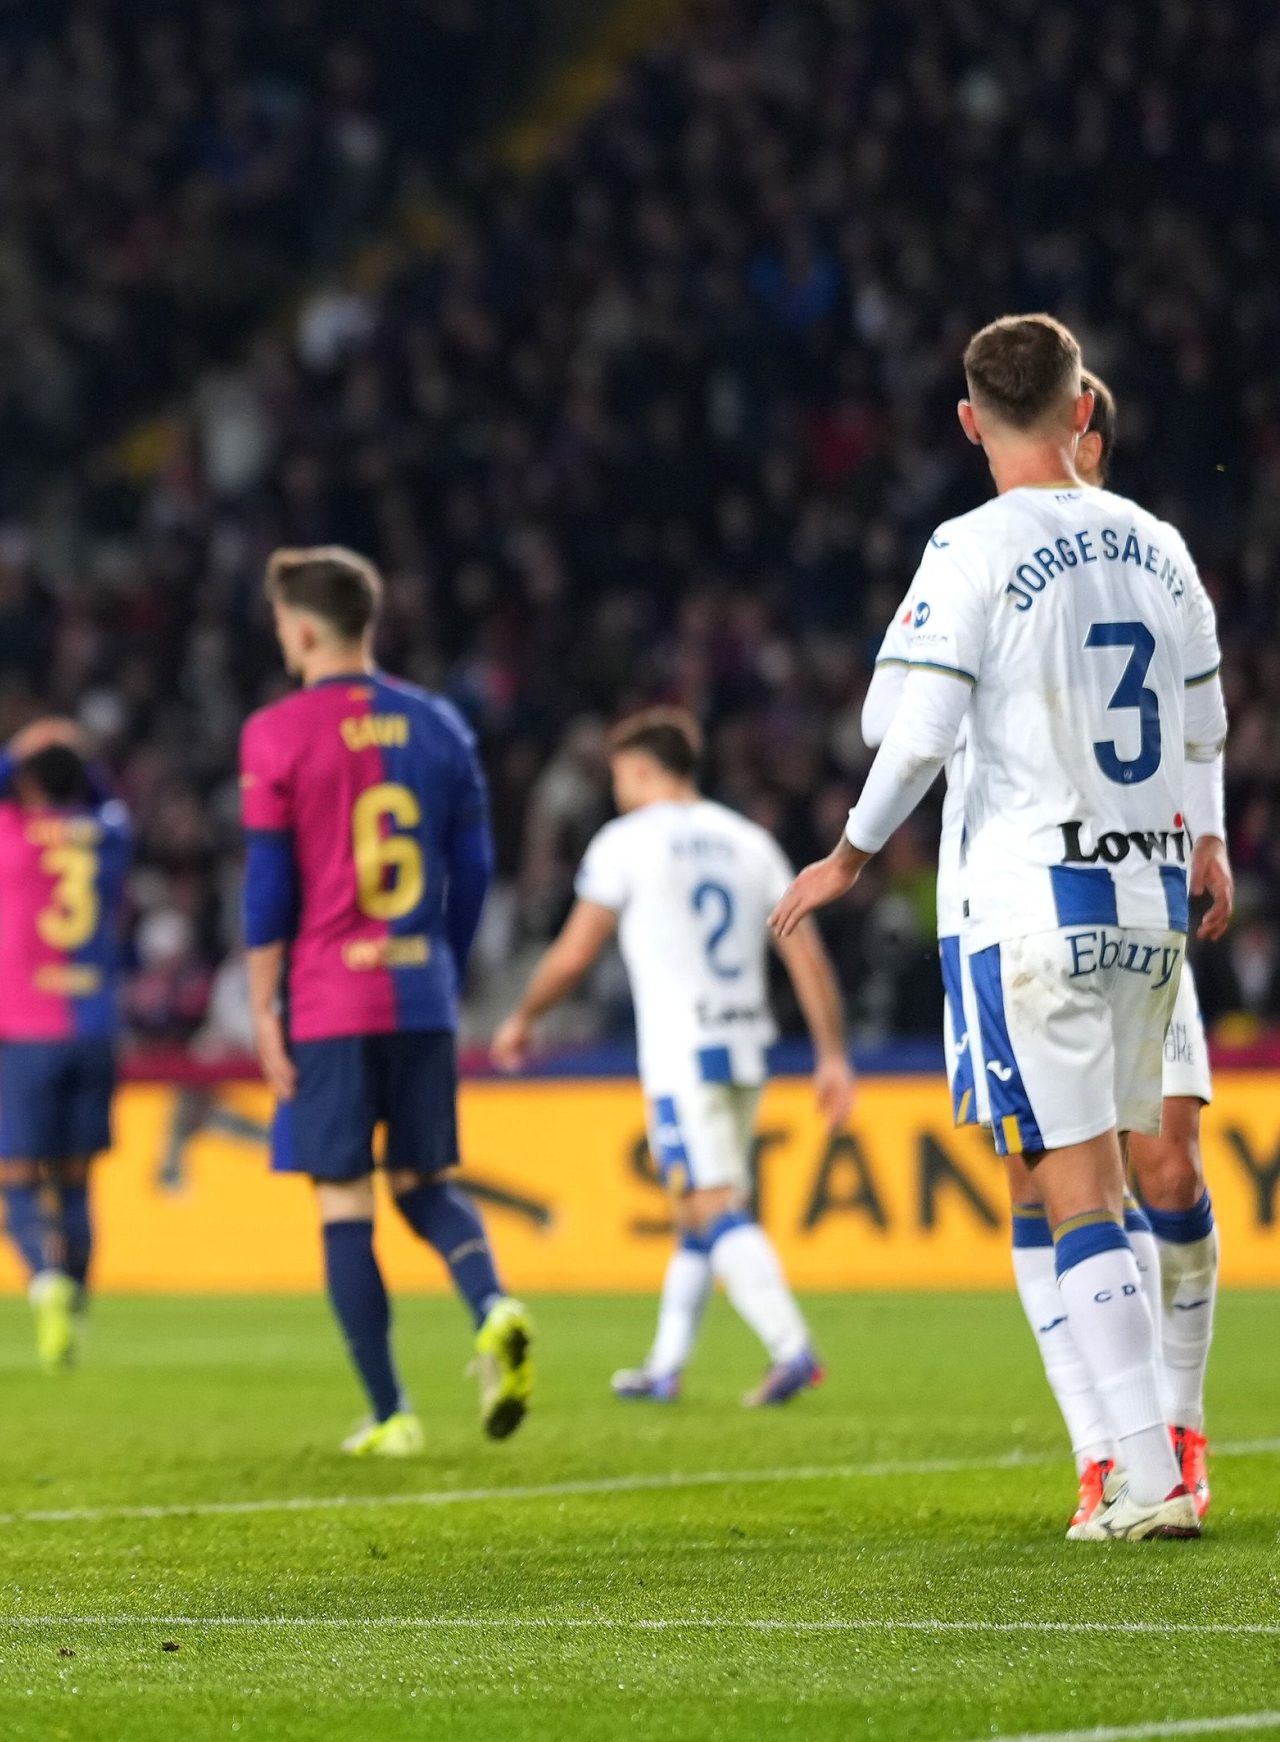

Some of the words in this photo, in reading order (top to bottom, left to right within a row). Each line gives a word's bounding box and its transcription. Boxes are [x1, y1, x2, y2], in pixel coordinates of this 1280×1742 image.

[1005, 531, 1097, 611] JORGE
[1083, 621, 1162, 785] 3
[352, 781, 425, 921] 6
[1057, 812, 1186, 864] Lowi
[35, 846, 100, 951] 3
[691, 878, 742, 979] 2
[1065, 930, 1180, 990] Ebury
